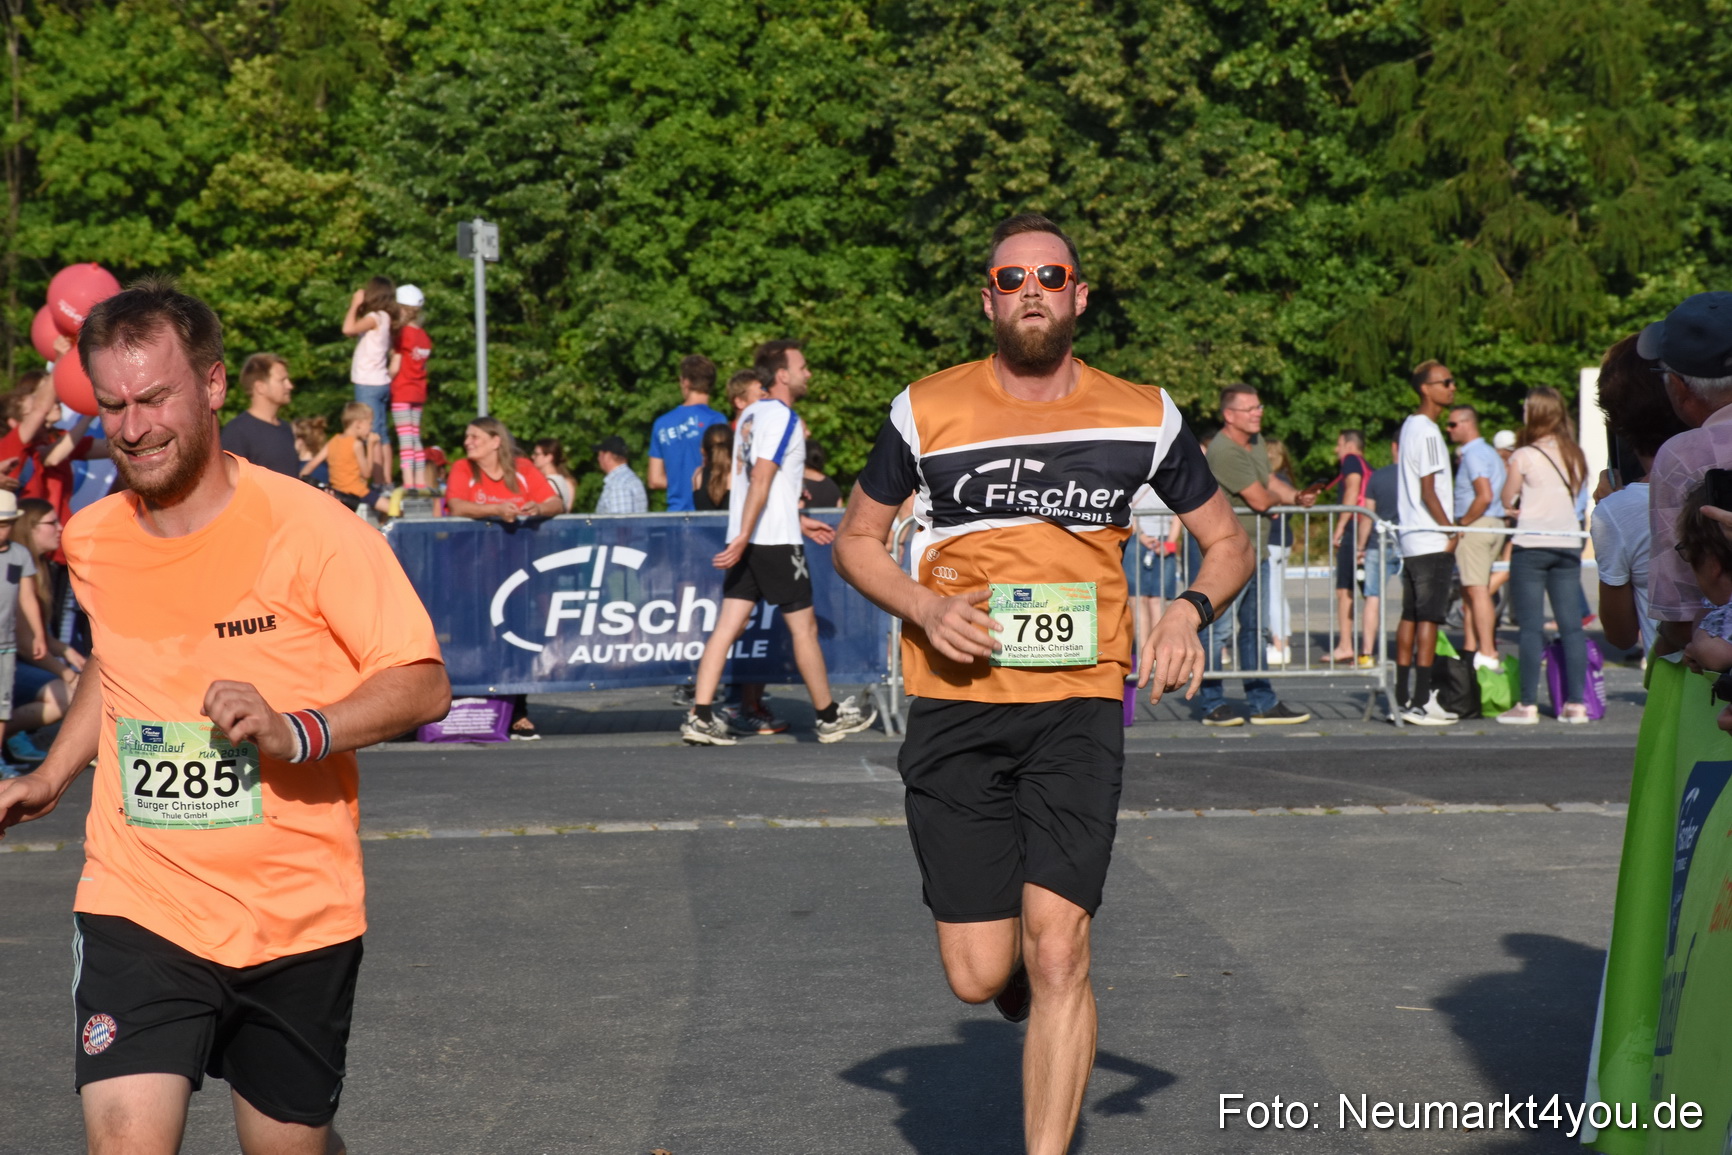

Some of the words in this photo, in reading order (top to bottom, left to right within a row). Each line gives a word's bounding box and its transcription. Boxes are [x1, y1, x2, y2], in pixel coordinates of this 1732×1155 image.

[985, 481, 1124, 508] Fischer
[1007, 506, 1113, 523] TOMOBILE
[1072, 604, 1090, 612] 2019
[214, 614, 277, 638] THULE
[1013, 613, 1074, 643] 789
[567, 640, 769, 664] AUTOMOILE
[1004, 644, 1046, 652] Woschnik
[134, 740, 186, 753] firmenlauf
[220, 747, 249, 759] 2019
[133, 759, 240, 799] 2285
[137, 799, 169, 812] Burger
[171, 800, 240, 811] Christopher
